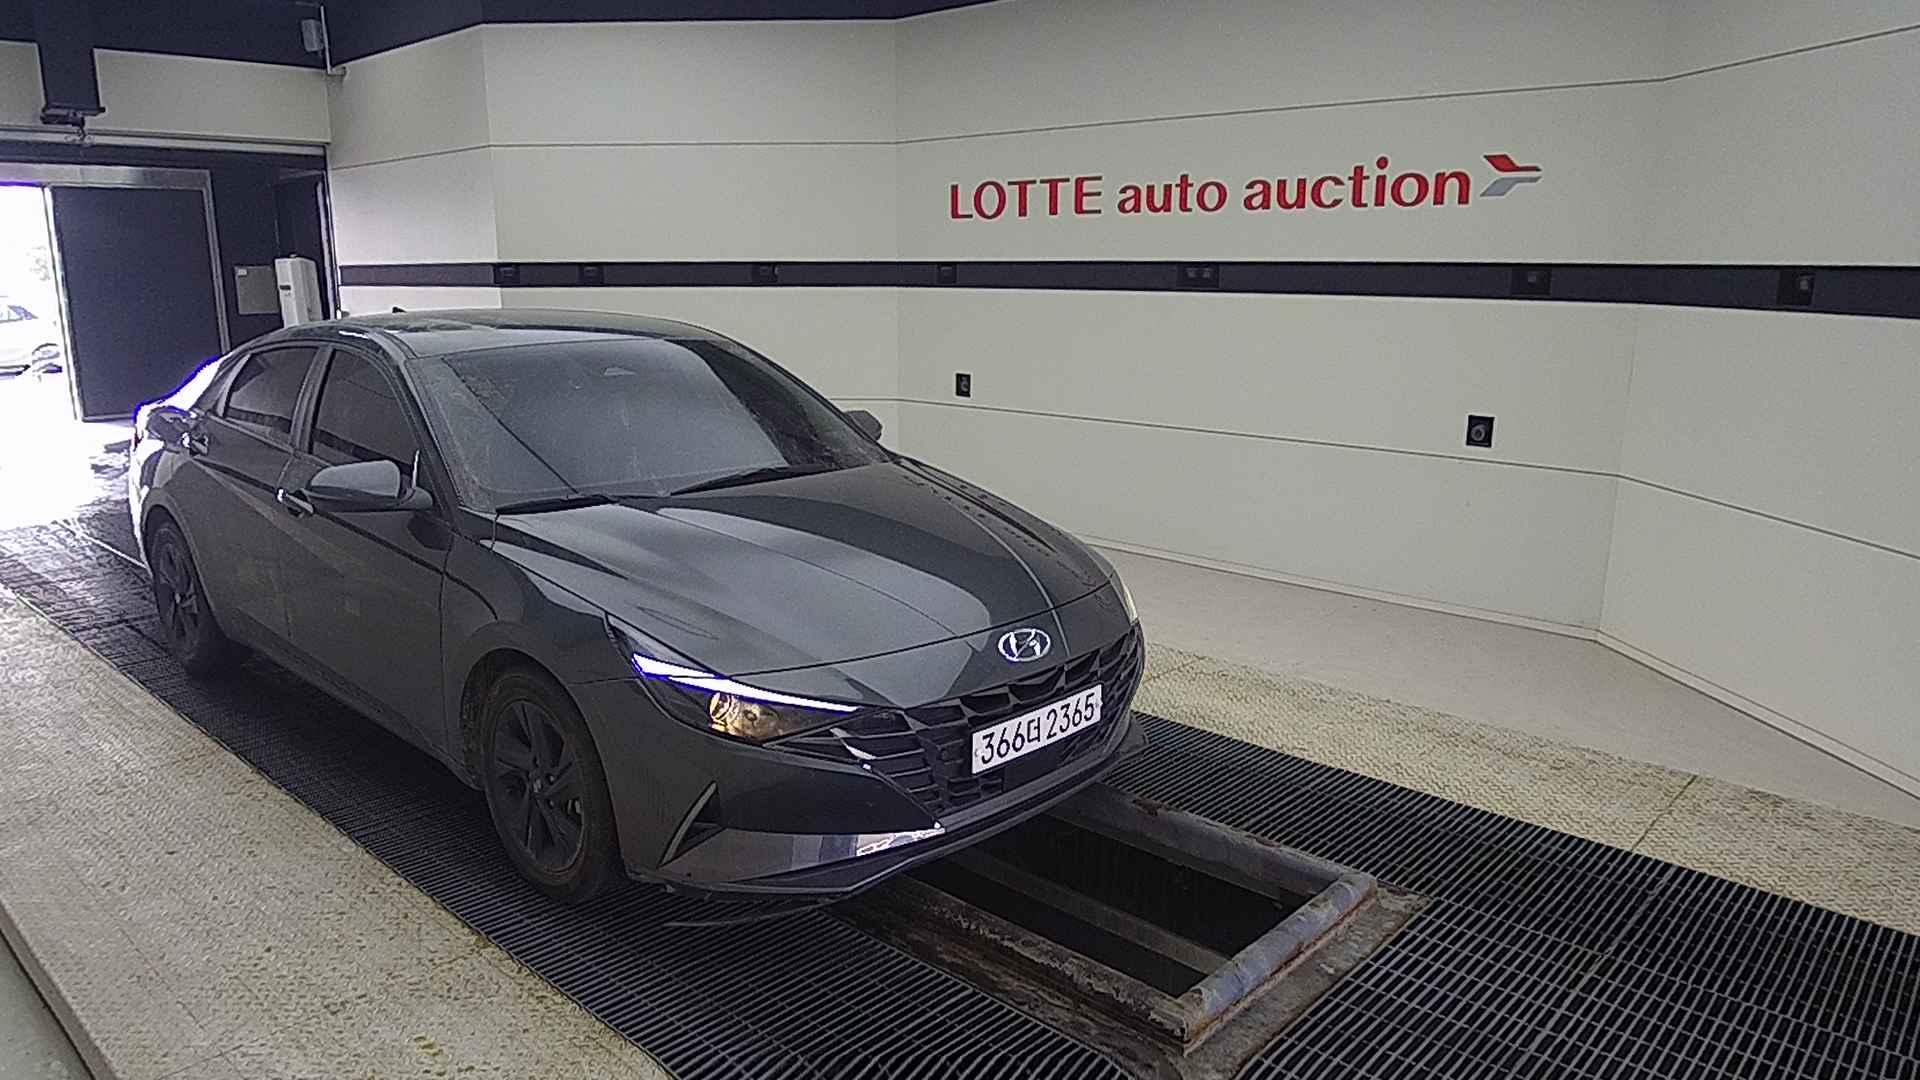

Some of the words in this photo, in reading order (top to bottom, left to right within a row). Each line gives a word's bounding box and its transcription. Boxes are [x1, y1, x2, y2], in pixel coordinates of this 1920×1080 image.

[949, 174, 1103, 220] LOTTE
[1117, 173, 1228, 215] auto
[1243, 156, 1471, 211] auction
